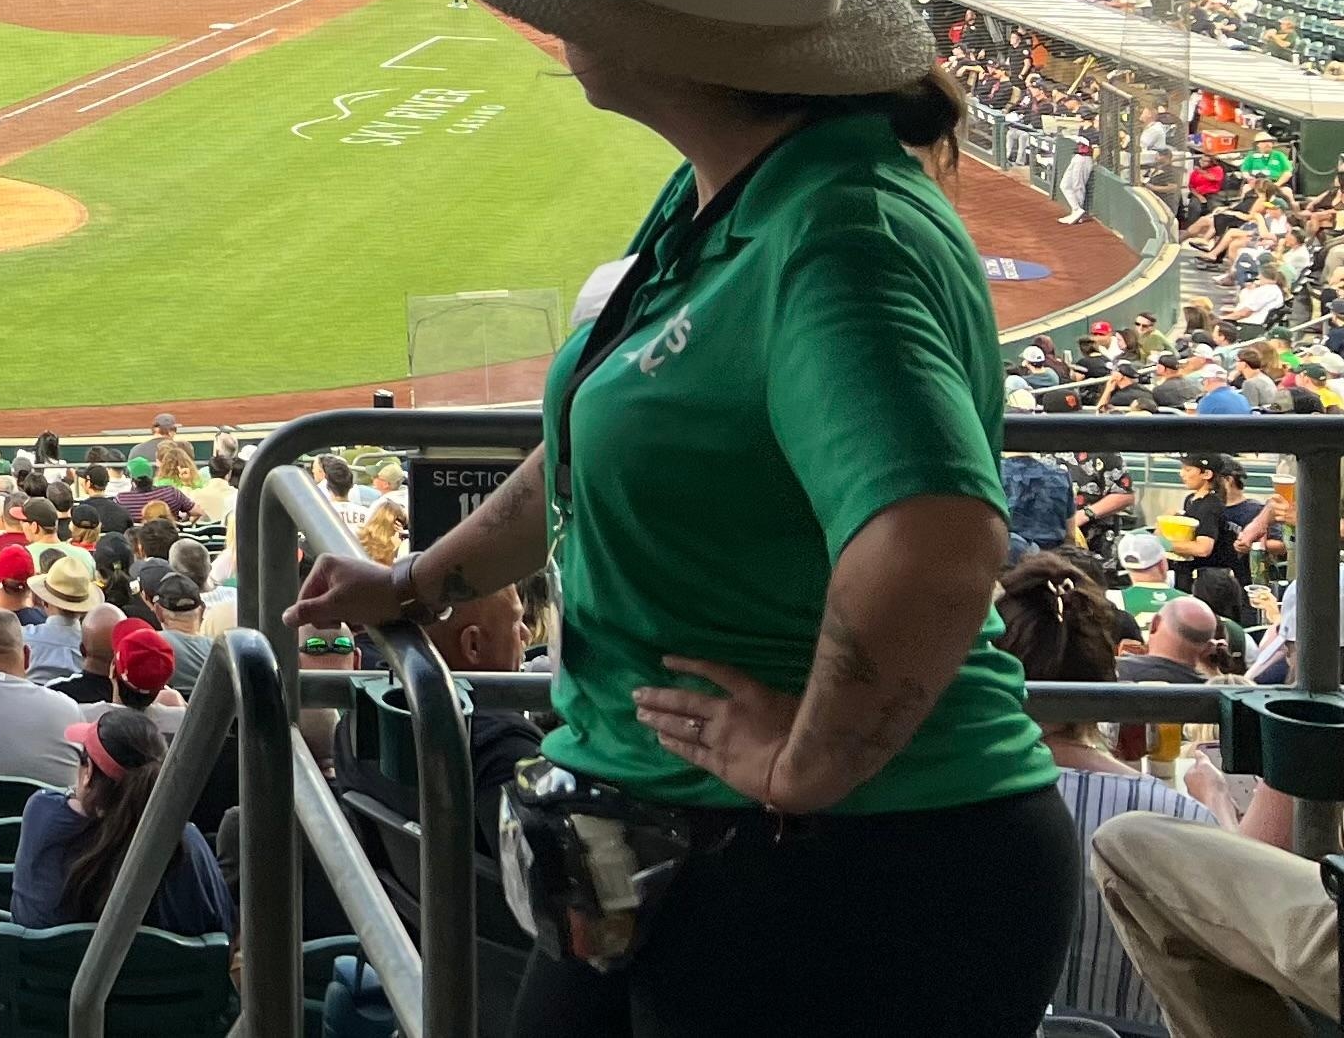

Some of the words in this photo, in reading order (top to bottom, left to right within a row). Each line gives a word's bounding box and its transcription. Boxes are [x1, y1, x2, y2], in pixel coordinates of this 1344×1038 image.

[339, 120, 425, 146] SKY
[384, 88, 486, 120] RIVER
[446, 104, 506, 134] CASINO
[432, 470, 509, 488] SECTIO
